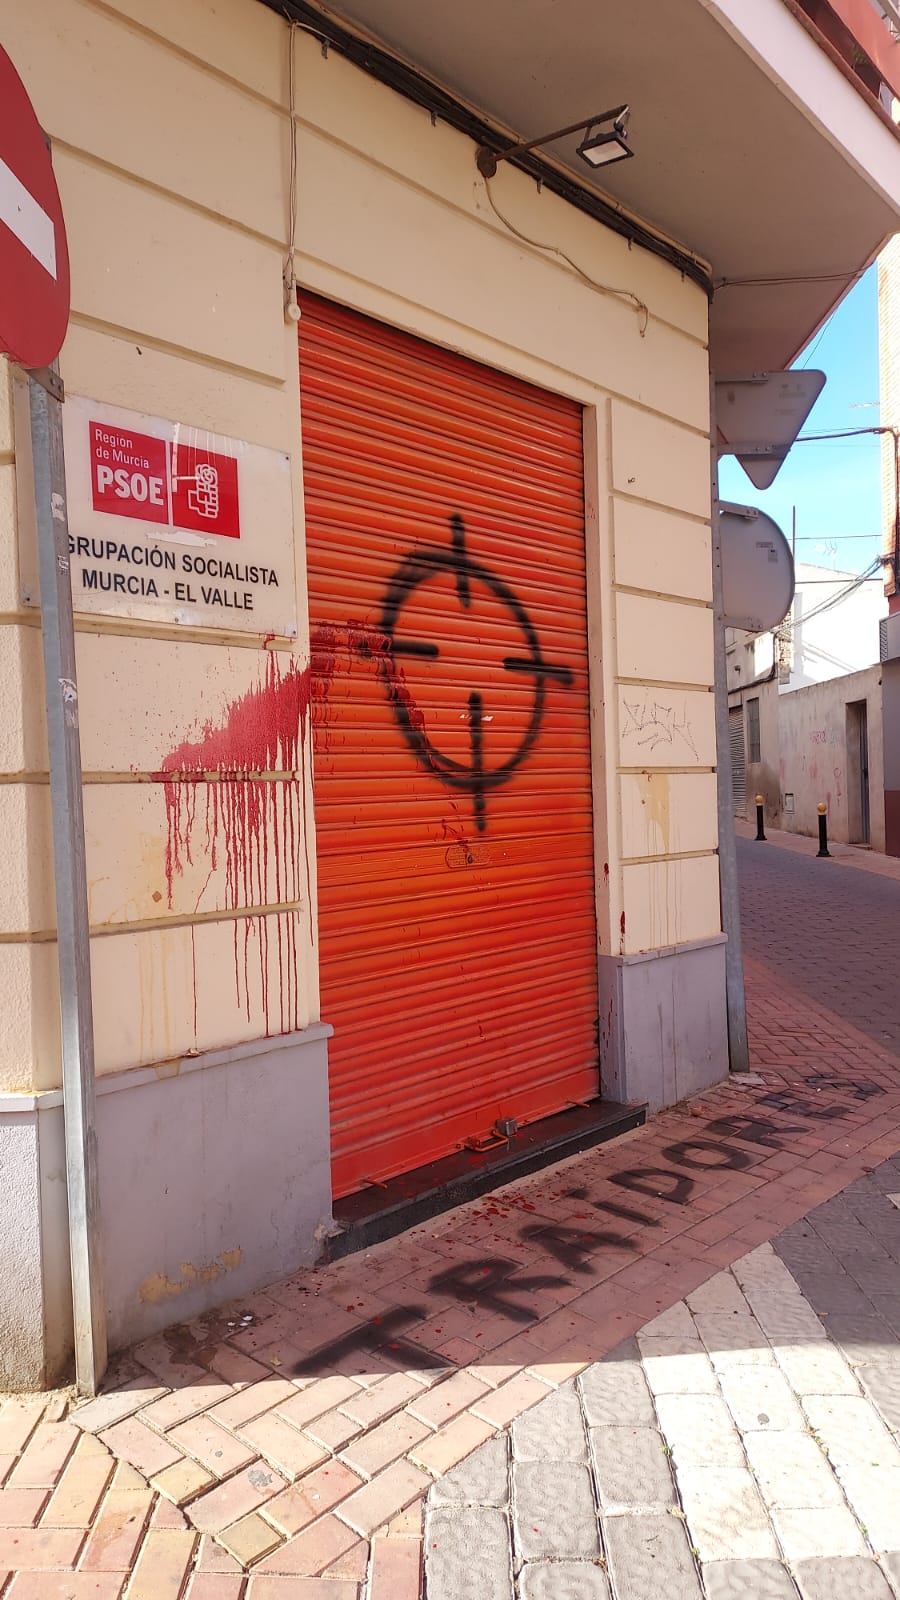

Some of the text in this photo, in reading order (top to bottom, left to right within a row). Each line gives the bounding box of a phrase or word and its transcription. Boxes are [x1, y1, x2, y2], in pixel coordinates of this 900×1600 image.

[95, 446, 150, 469] de Murcia
[96, 464, 164, 506] PSOE
[67, 534, 279, 587] GRUPACIÓN SOCIALISTA
[82, 568, 159, 597] MURCIA
[174, 582, 197, 603] EL
[201, 585, 254, 610] VALLE
